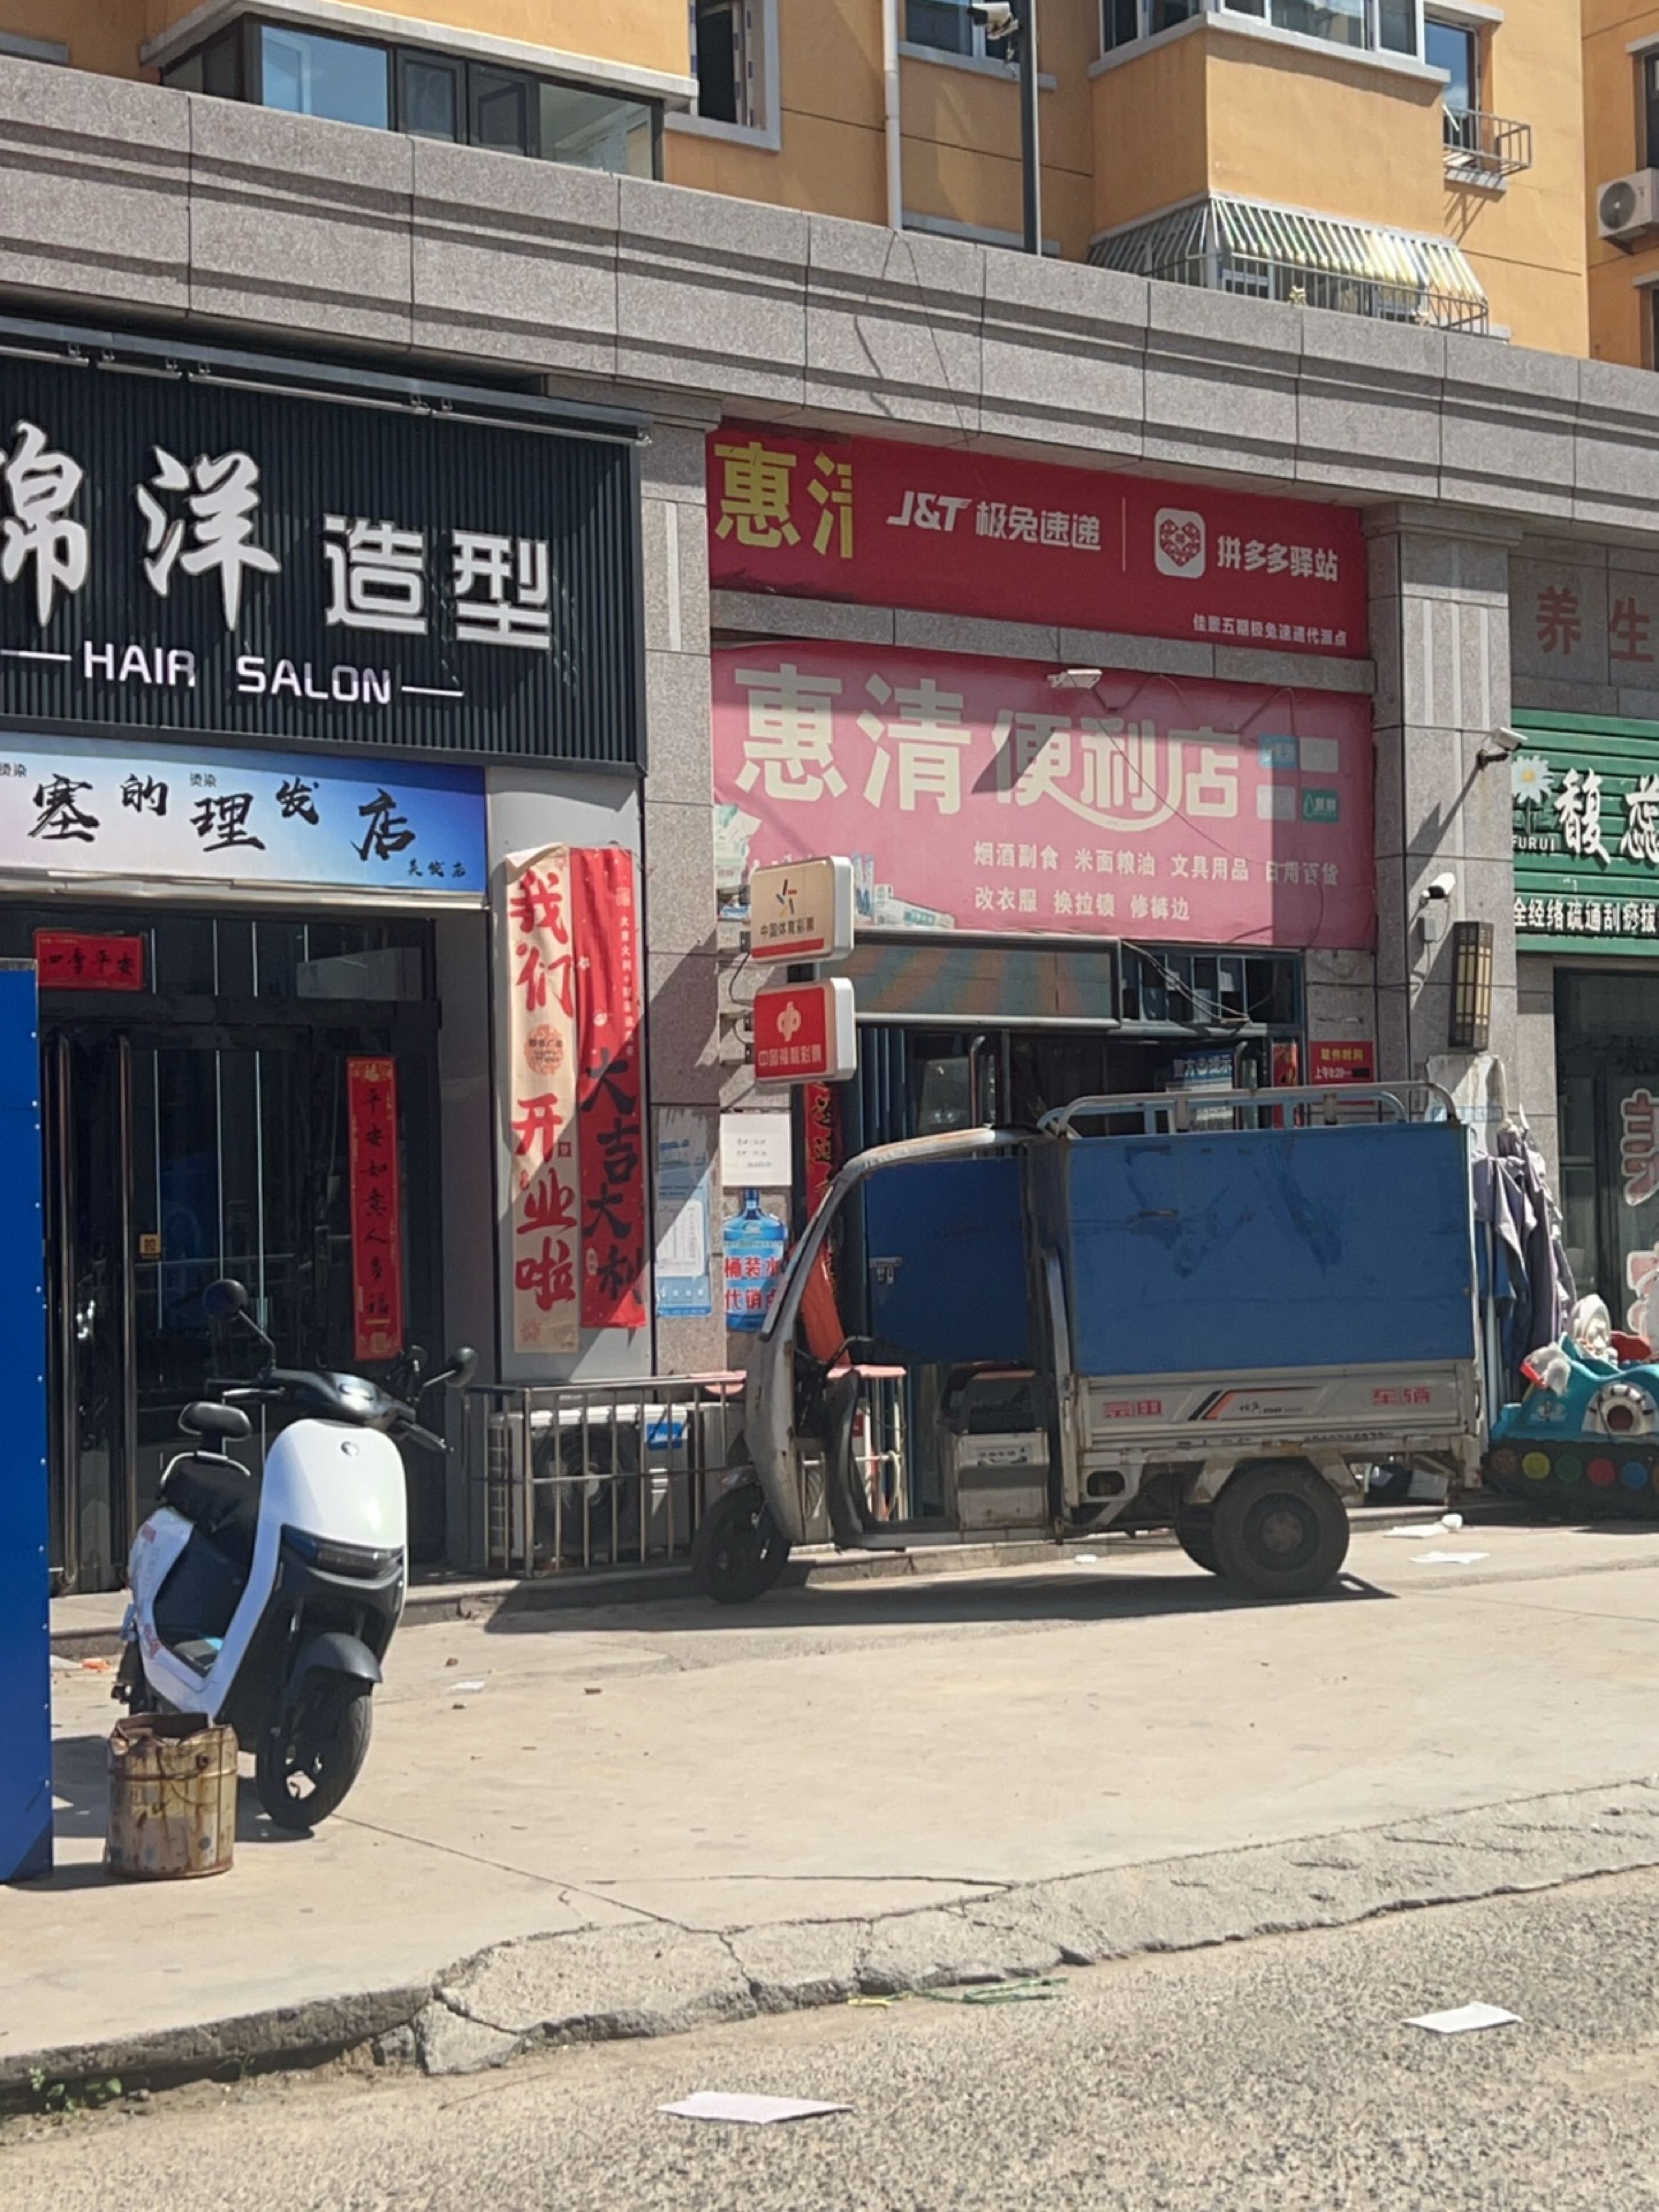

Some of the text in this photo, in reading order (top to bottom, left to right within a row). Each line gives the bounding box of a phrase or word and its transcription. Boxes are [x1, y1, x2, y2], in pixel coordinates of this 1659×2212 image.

[888, 490, 1102, 551] J&T 极兔速递
[1217, 534, 1338, 581] 拼多多驿站
[1536, 585, 1654, 663] 养生
[84, 641, 391, 704] HAIR SALON
[734, 663, 1240, 831] 惠清便利店
[28, 773, 417, 862] 塞的理发店
[1512, 835, 1555, 851] FURUI
[974, 842, 1338, 886] 烟酒副食 米面粮油 文具用品 日用百货
[975, 886, 1037, 913] 改衣服
[1053, 890, 1115, 917] 换拉锁
[581, 1046, 644, 1306] 大吉大利
